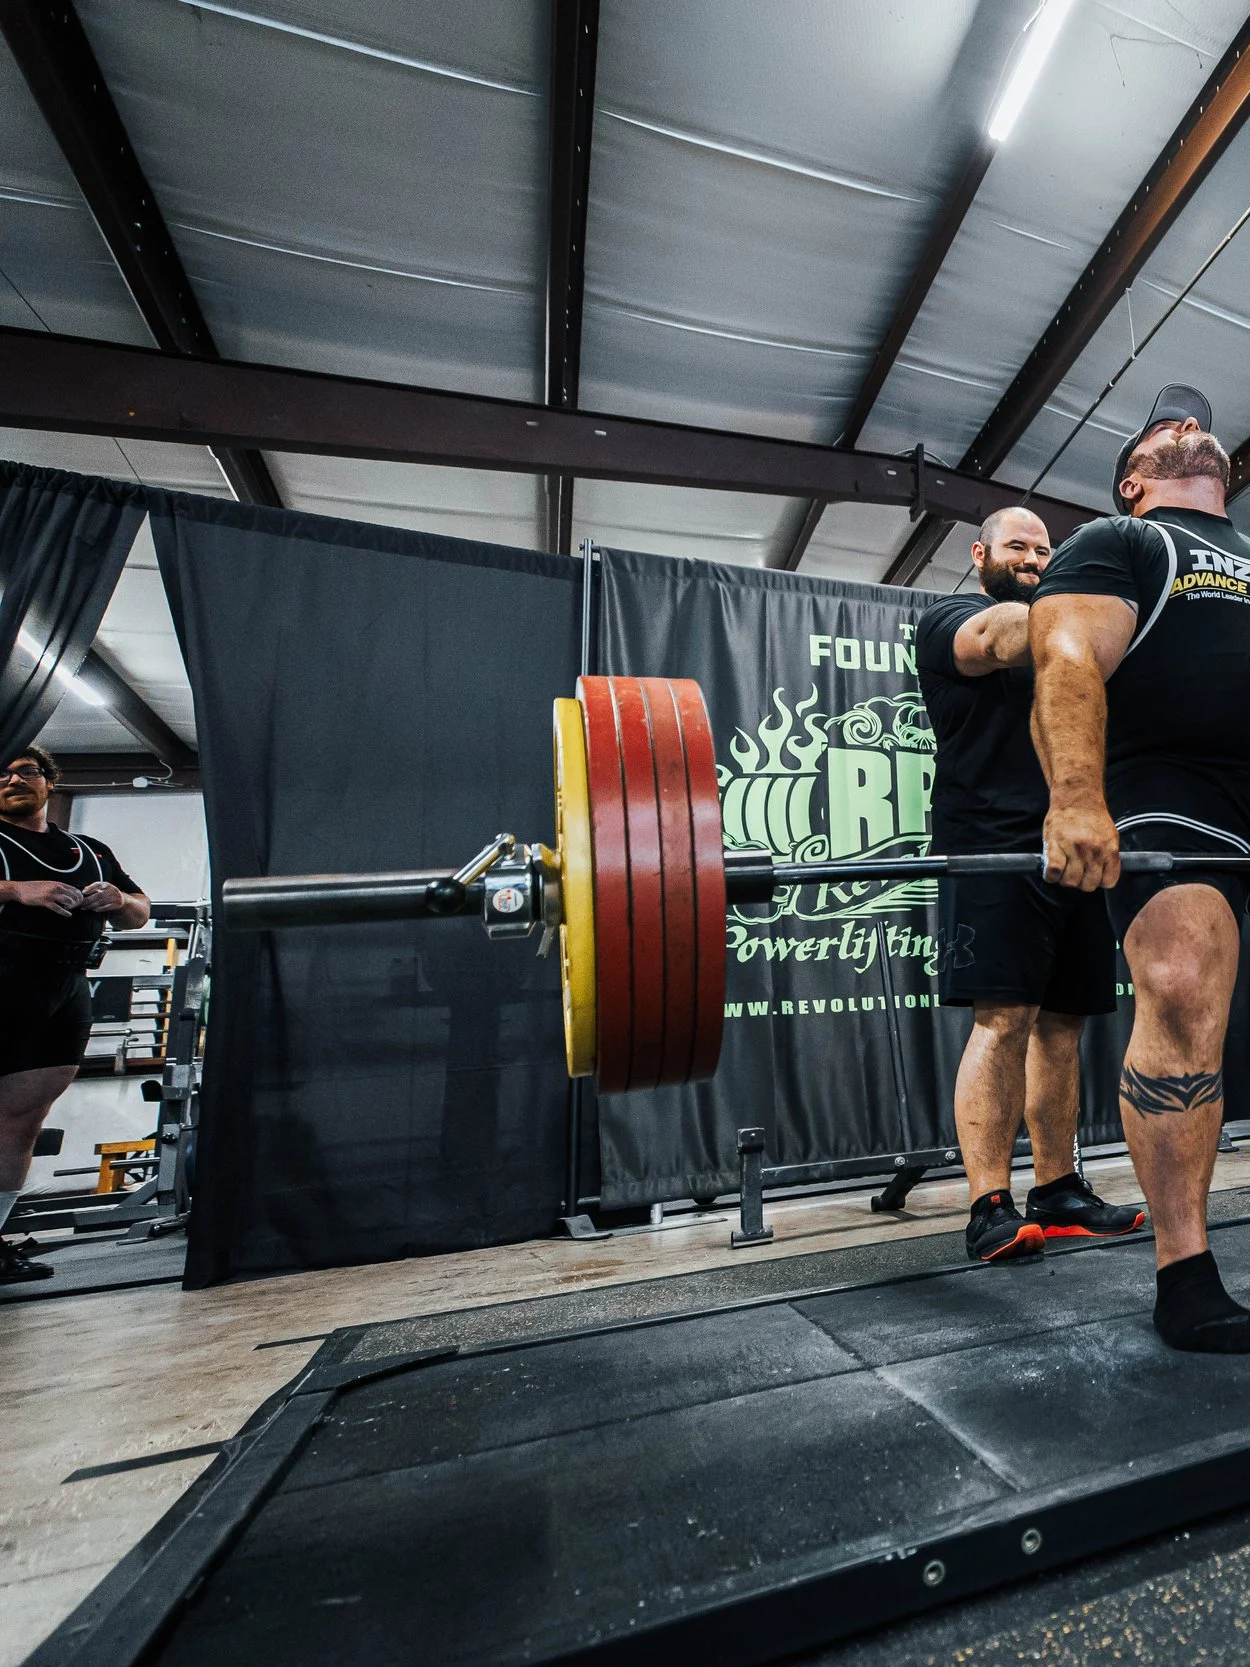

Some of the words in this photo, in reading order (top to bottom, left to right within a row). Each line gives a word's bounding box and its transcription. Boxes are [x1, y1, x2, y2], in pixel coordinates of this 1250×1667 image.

[1170, 572, 1248, 595] ADVANCE
[1186, 592, 1200, 601] The
[1200, 590, 1220, 599] World
[1221, 591, 1243, 603] Leader
[899, 623, 918, 640] T
